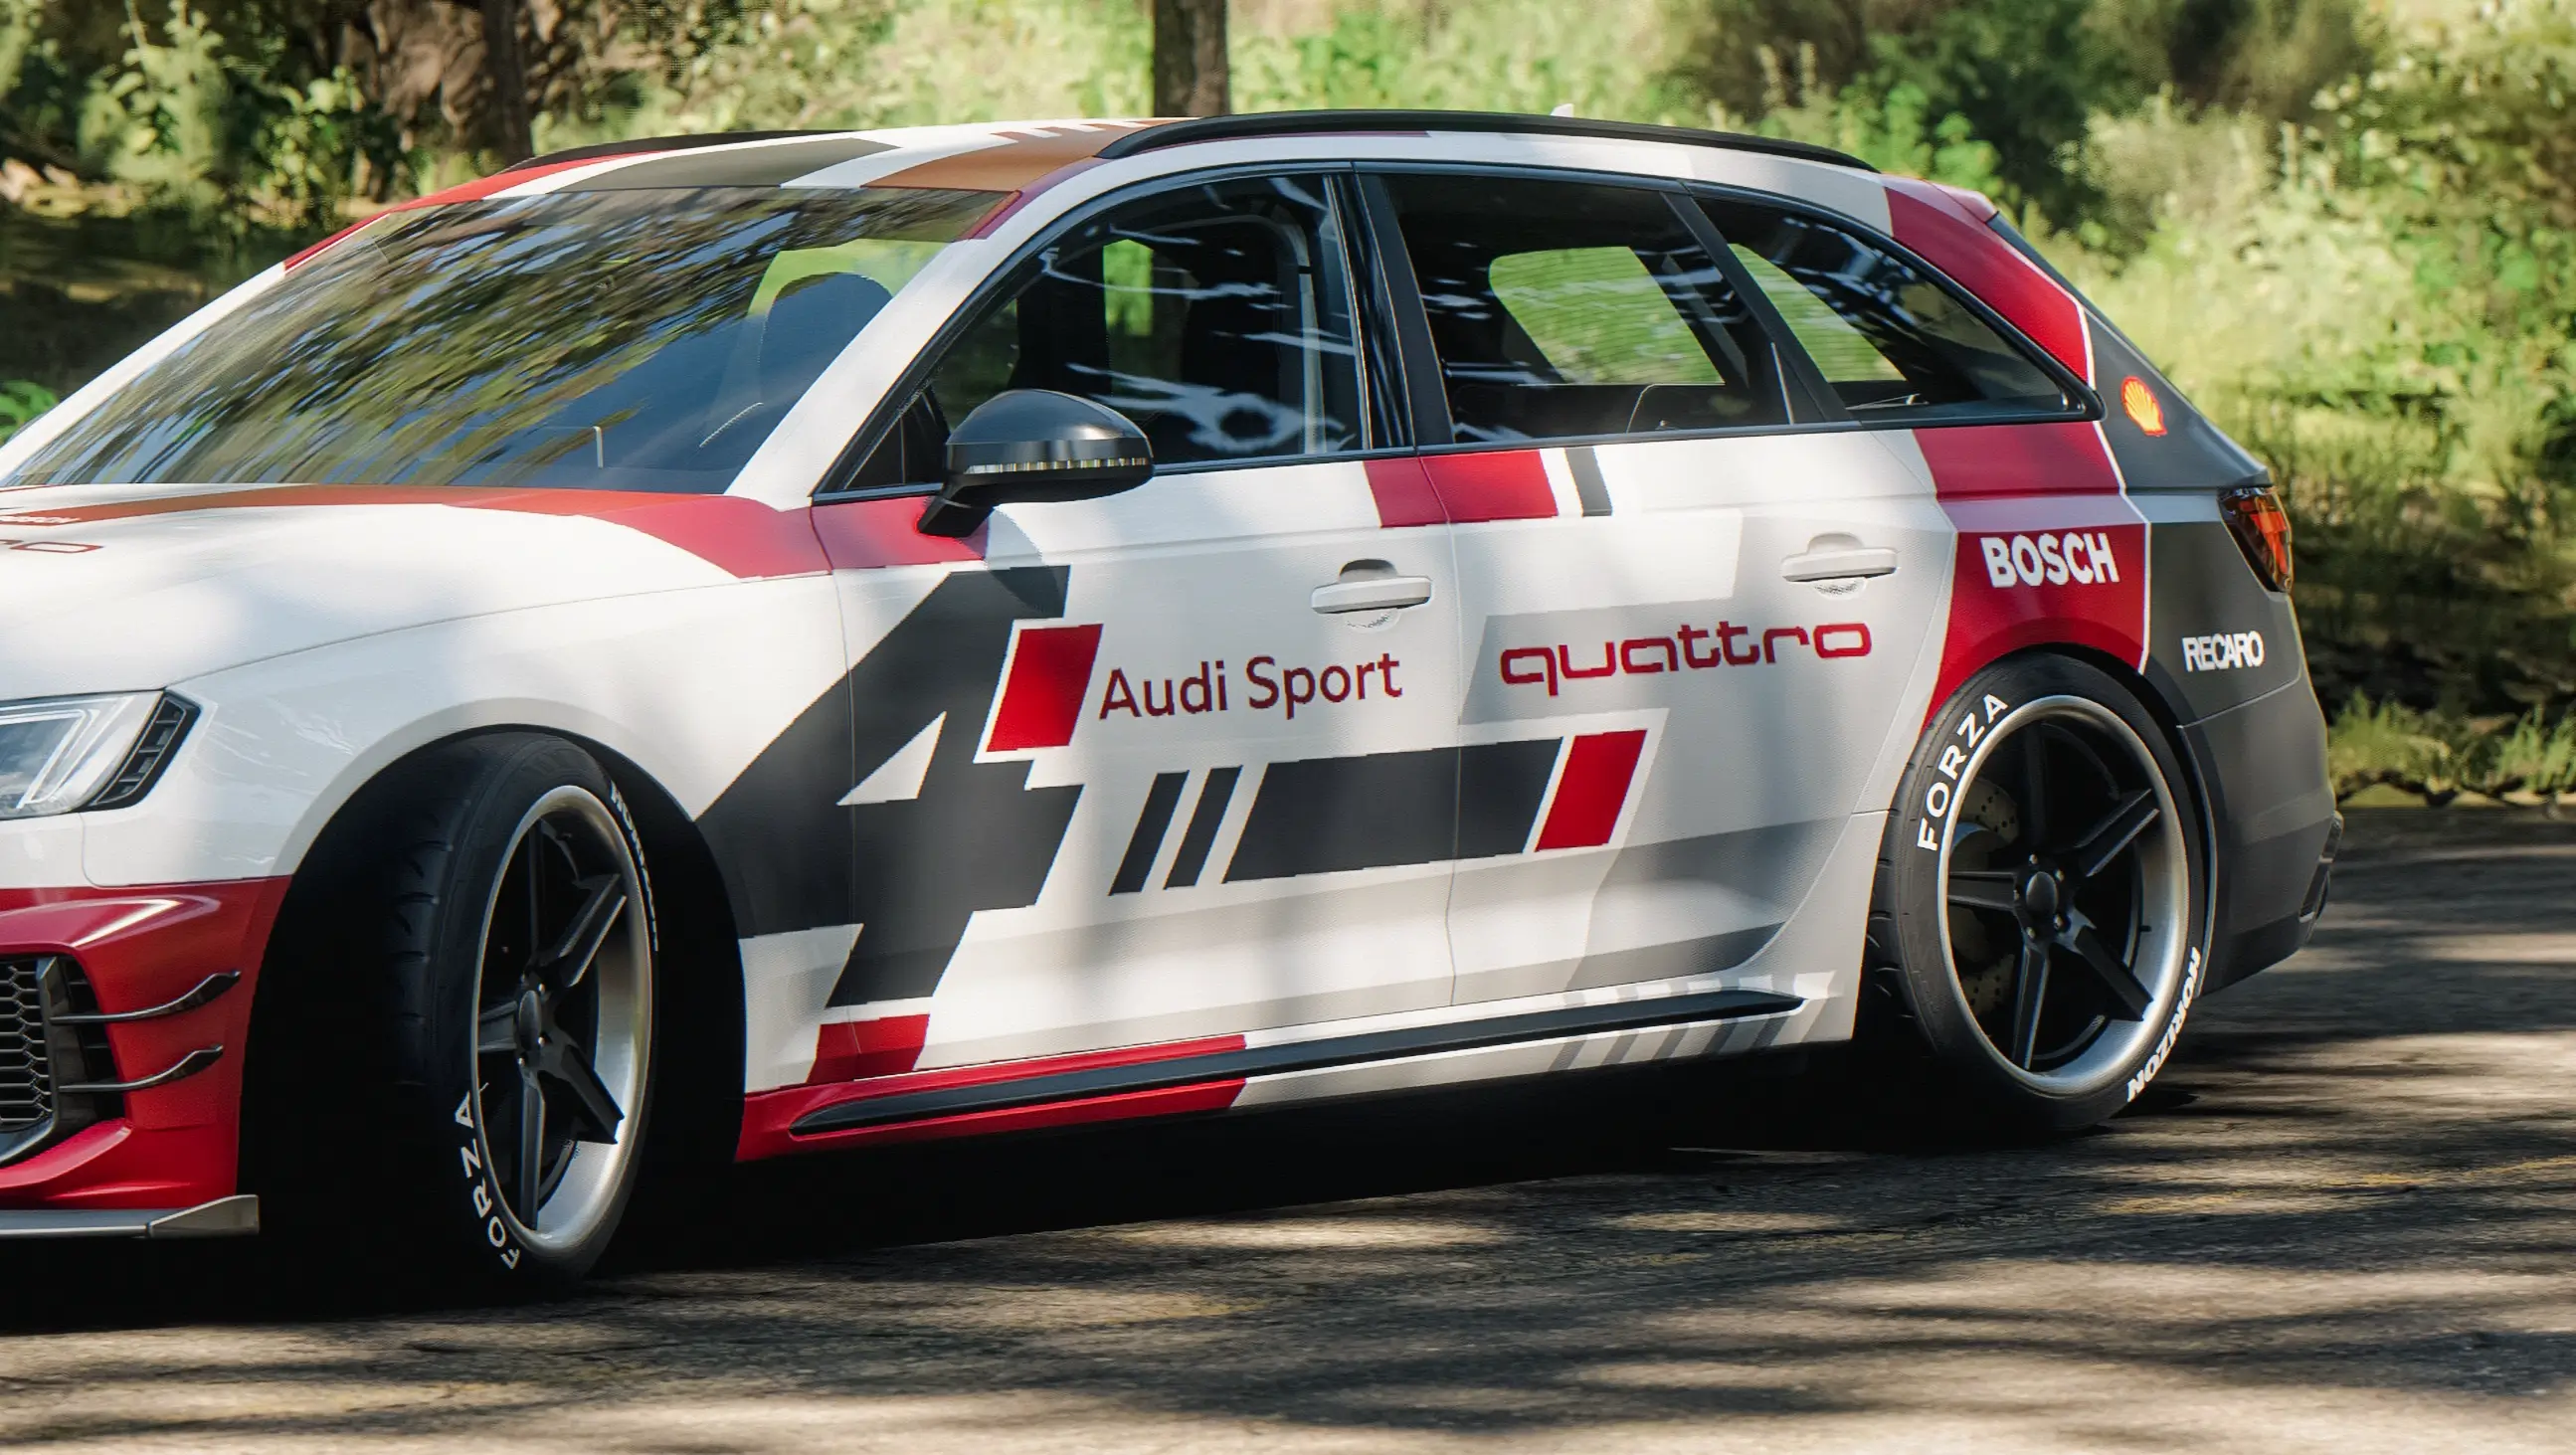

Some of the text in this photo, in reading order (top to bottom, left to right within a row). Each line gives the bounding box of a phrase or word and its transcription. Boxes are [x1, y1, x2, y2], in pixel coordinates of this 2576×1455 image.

[1980, 532, 2120, 588] BOSCH
[1099, 652, 1403, 720] Audi Sport
[1500, 621, 1872, 697] quattro
[2182, 630, 2265, 672] RECARO
[1917, 693, 2009, 852] FORZA
[2126, 946, 2201, 1103] HORIZON
[455, 1090, 521, 1270] FORZA
